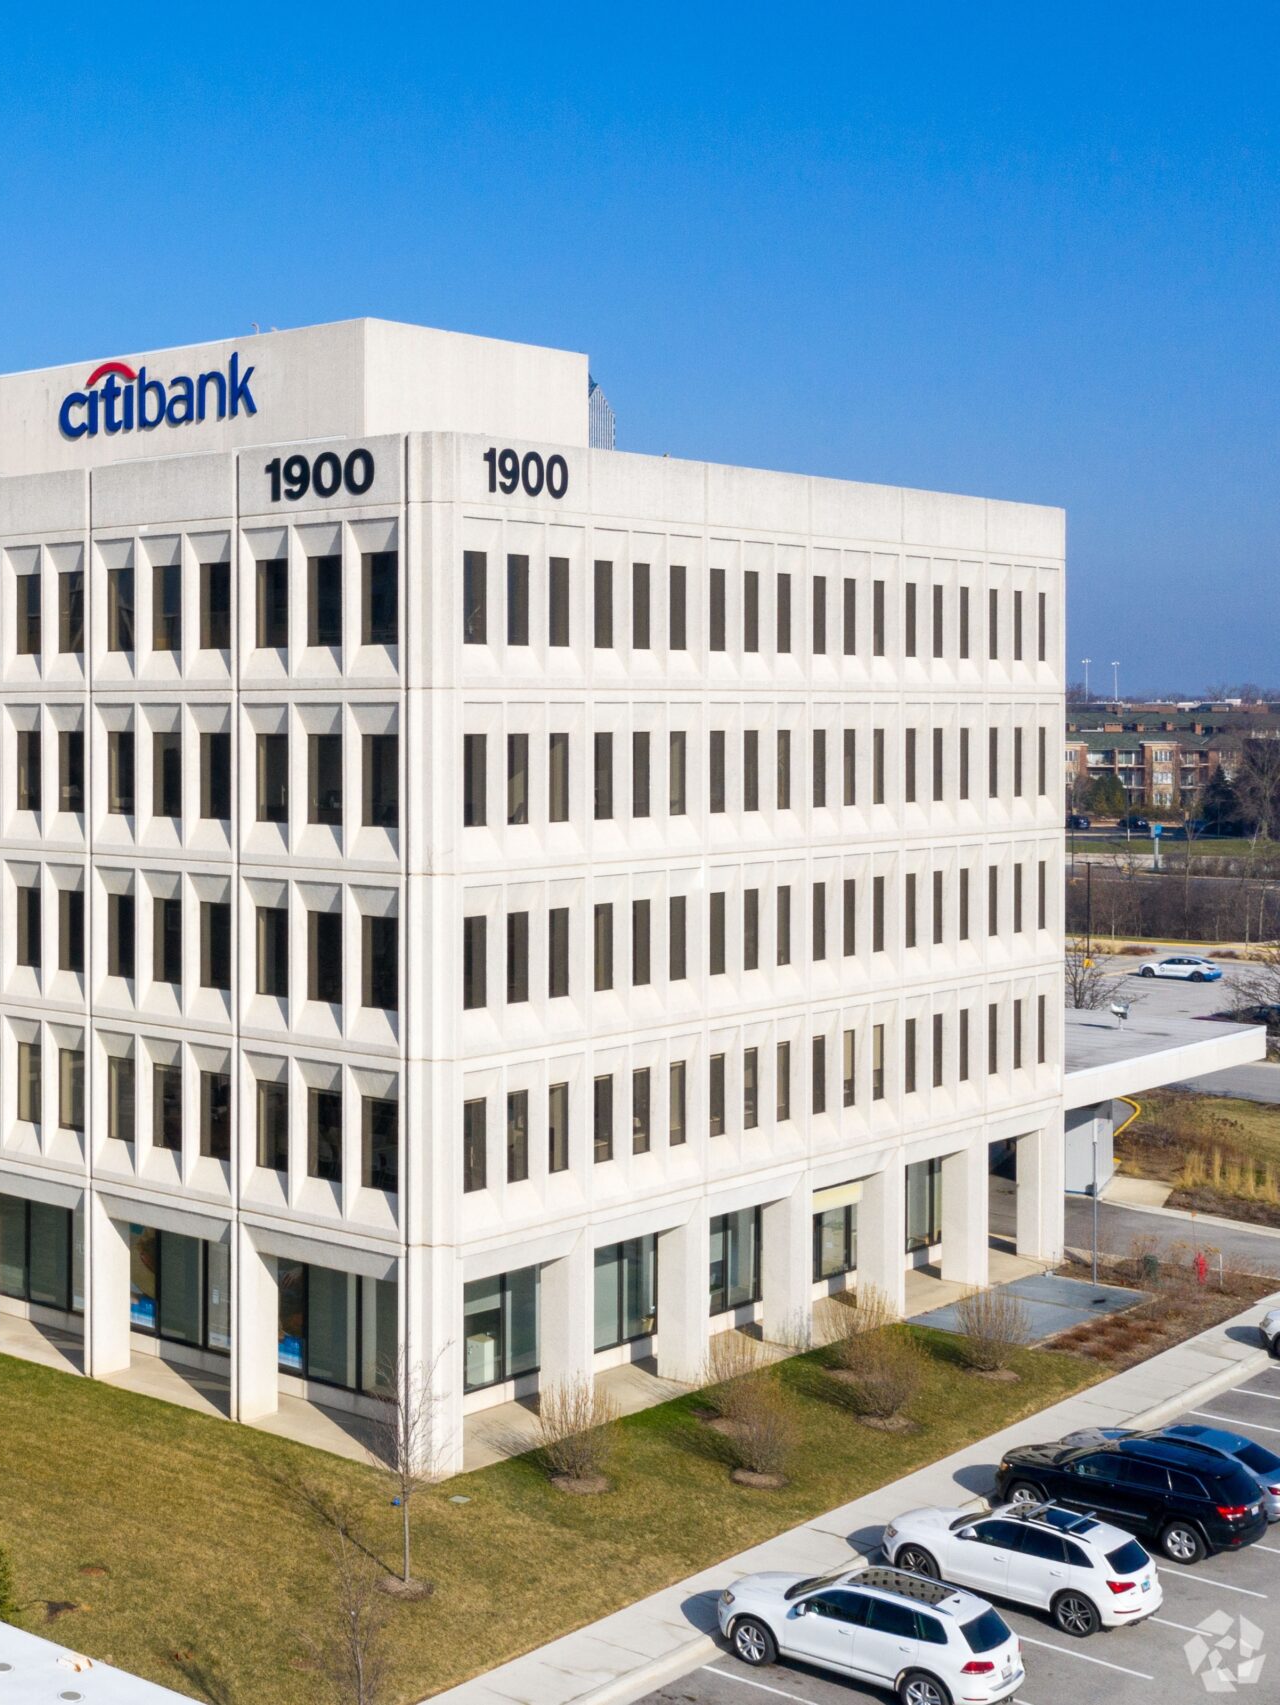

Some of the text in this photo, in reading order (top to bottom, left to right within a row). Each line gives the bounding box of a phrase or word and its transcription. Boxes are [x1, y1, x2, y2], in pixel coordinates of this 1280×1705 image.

[60, 352, 258, 437] citibank
[265, 448, 375, 502] 1900
[483, 447, 569, 500] 1900
